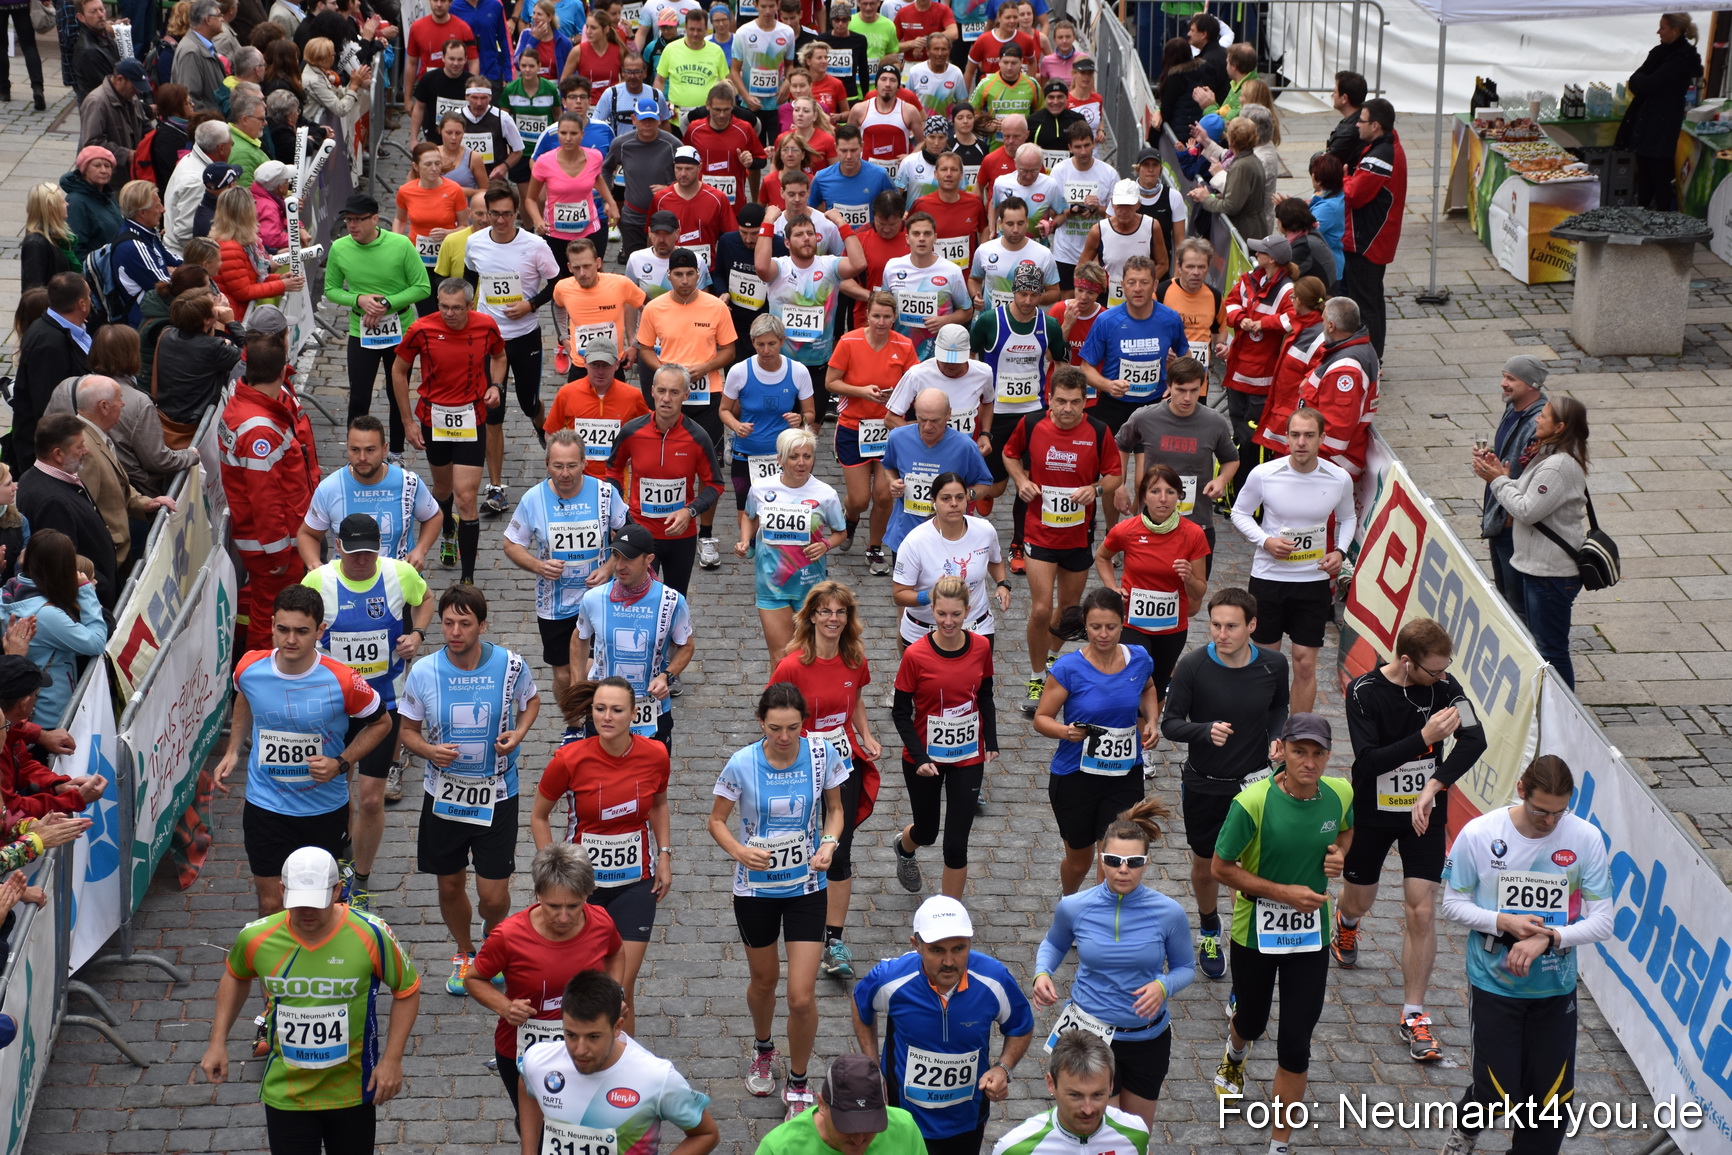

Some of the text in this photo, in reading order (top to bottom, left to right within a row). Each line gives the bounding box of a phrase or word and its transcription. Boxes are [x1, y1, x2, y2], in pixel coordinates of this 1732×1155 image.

[828, 56, 850, 67] 2249
[676, 65, 712, 77] FINISHER
[753, 76, 777, 88] 2579
[992, 100, 1030, 110] BOCK
[519, 121, 545, 131] 2596
[466, 141, 486, 153] 323
[1070, 189, 1091, 203] 347
[558, 208, 586, 221] 2784
[289, 219, 297, 242] BMW
[942, 245, 963, 259] 146
[493, 281, 510, 295] 53
[740, 282, 755, 296] 58
[737, 296, 754, 306] Charles
[903, 300, 934, 314] 2505
[786, 313, 819, 329] 2541
[365, 322, 398, 336] 2644
[370, 337, 394, 345] Thorsten
[1120, 339, 1159, 349] HUBER
[1124, 367, 1157, 383] 2545
[1007, 382, 1031, 395] 536
[444, 413, 463, 428] 68
[580, 430, 615, 444] 2424
[1160, 435, 1198, 454] NIXON
[589, 447, 605, 455] Klaus
[404, 487, 412, 515] VIERTL
[645, 487, 682, 503] 2107
[766, 514, 806, 530] 2646
[1056, 515, 1073, 523] Peter
[554, 532, 596, 550] 2112
[774, 532, 797, 540] Izabela
[1292, 536, 1312, 550] 26
[568, 553, 584, 561] Hans
[1132, 592, 1148, 600] PARTL
[614, 605, 653, 614] VIERTL
[1135, 600, 1175, 617] 3060
[660, 601, 670, 633] VIERTL
[342, 643, 379, 661] 149
[504, 674, 514, 707] VIERTL
[951, 708, 965, 716] DEHN
[929, 718, 971, 727] PARTL Neumarkt
[933, 724, 975, 746] 2555
[265, 744, 317, 763] 2689
[945, 747, 963, 756] Julia
[1094, 737, 1132, 758] 2359
[1097, 760, 1121, 770] Melitta
[1399, 764, 1427, 773] Neumarkt
[441, 773, 457, 781] PARTL
[766, 771, 807, 779] VIERTL
[766, 778, 808, 787] DESIGN GmbH
[1390, 774, 1425, 793] 139
[441, 783, 490, 805] 2700
[448, 807, 479, 817] Gerhard
[611, 806, 628, 815] DEHN
[1321, 819, 1337, 831] AOK
[605, 838, 633, 846] Neumarkt
[748, 838, 796, 849] PARTL Neumarkt
[588, 846, 637, 867] 2558
[598, 871, 625, 880] Bettina
[767, 871, 791, 881] Katrin
[1525, 877, 1558, 885] Neumarkt
[1506, 885, 1563, 909] 2692
[1263, 910, 1315, 931] 2468
[1276, 935, 1302, 946] Albert
[265, 976, 360, 998] BOCK
[278, 1010, 335, 1020] PARTL Neumarkt
[283, 1021, 342, 1045] 2794
[296, 1050, 330, 1060] Markus
[909, 1053, 967, 1065] PARTL Neumarkt
[913, 1063, 972, 1087] 2269
[543, 1095, 563, 1105] PARTL
[927, 1090, 954, 1101] Xaver
[546, 1125, 603, 1142] PARTL Neumarkt
